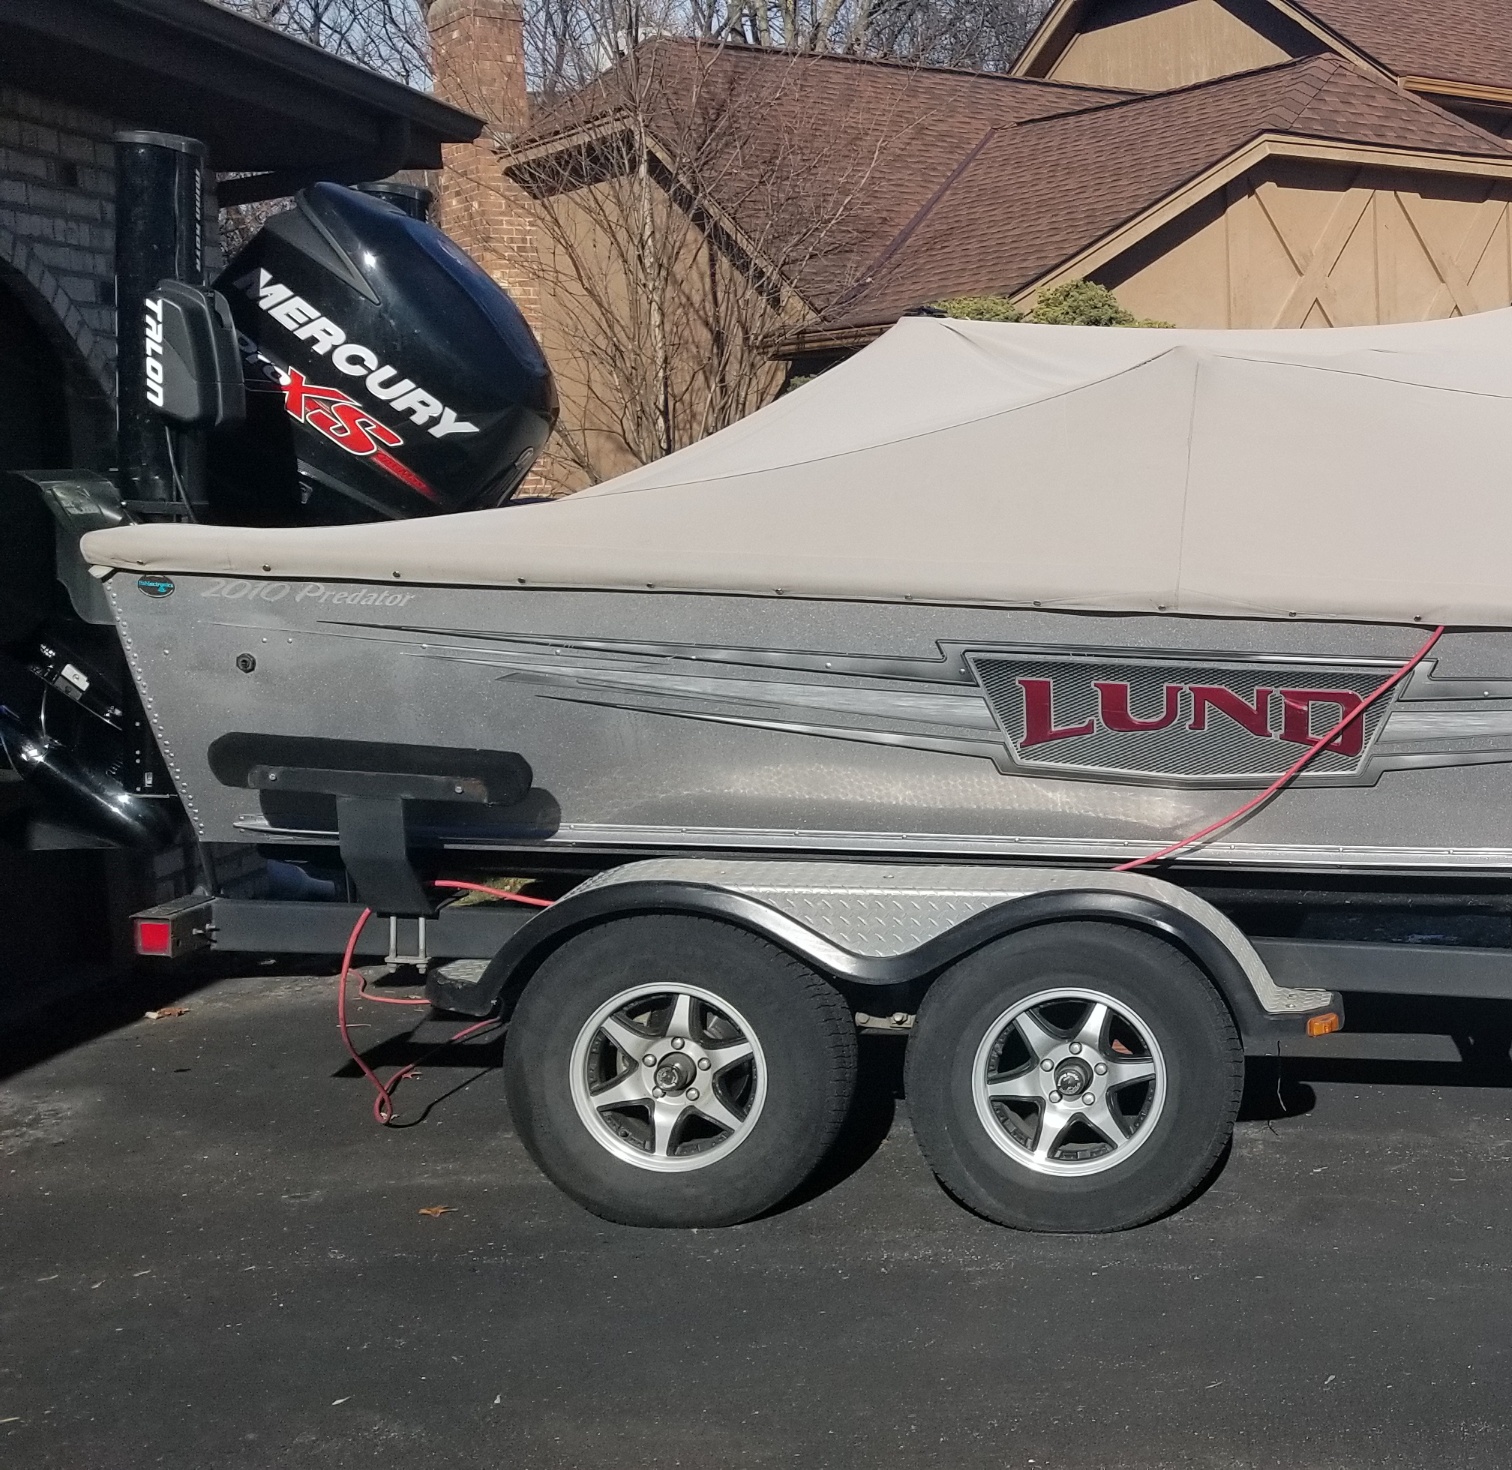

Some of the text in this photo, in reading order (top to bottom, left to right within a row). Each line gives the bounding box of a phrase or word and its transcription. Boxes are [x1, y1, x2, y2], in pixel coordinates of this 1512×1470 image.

[145, 298, 163, 407] TALON
[233, 267, 480, 438] MERCURY
[285, 366, 404, 455] XS
[202, 579, 416, 607] 2010 Predator
[1016, 678, 1365, 757] LUND
